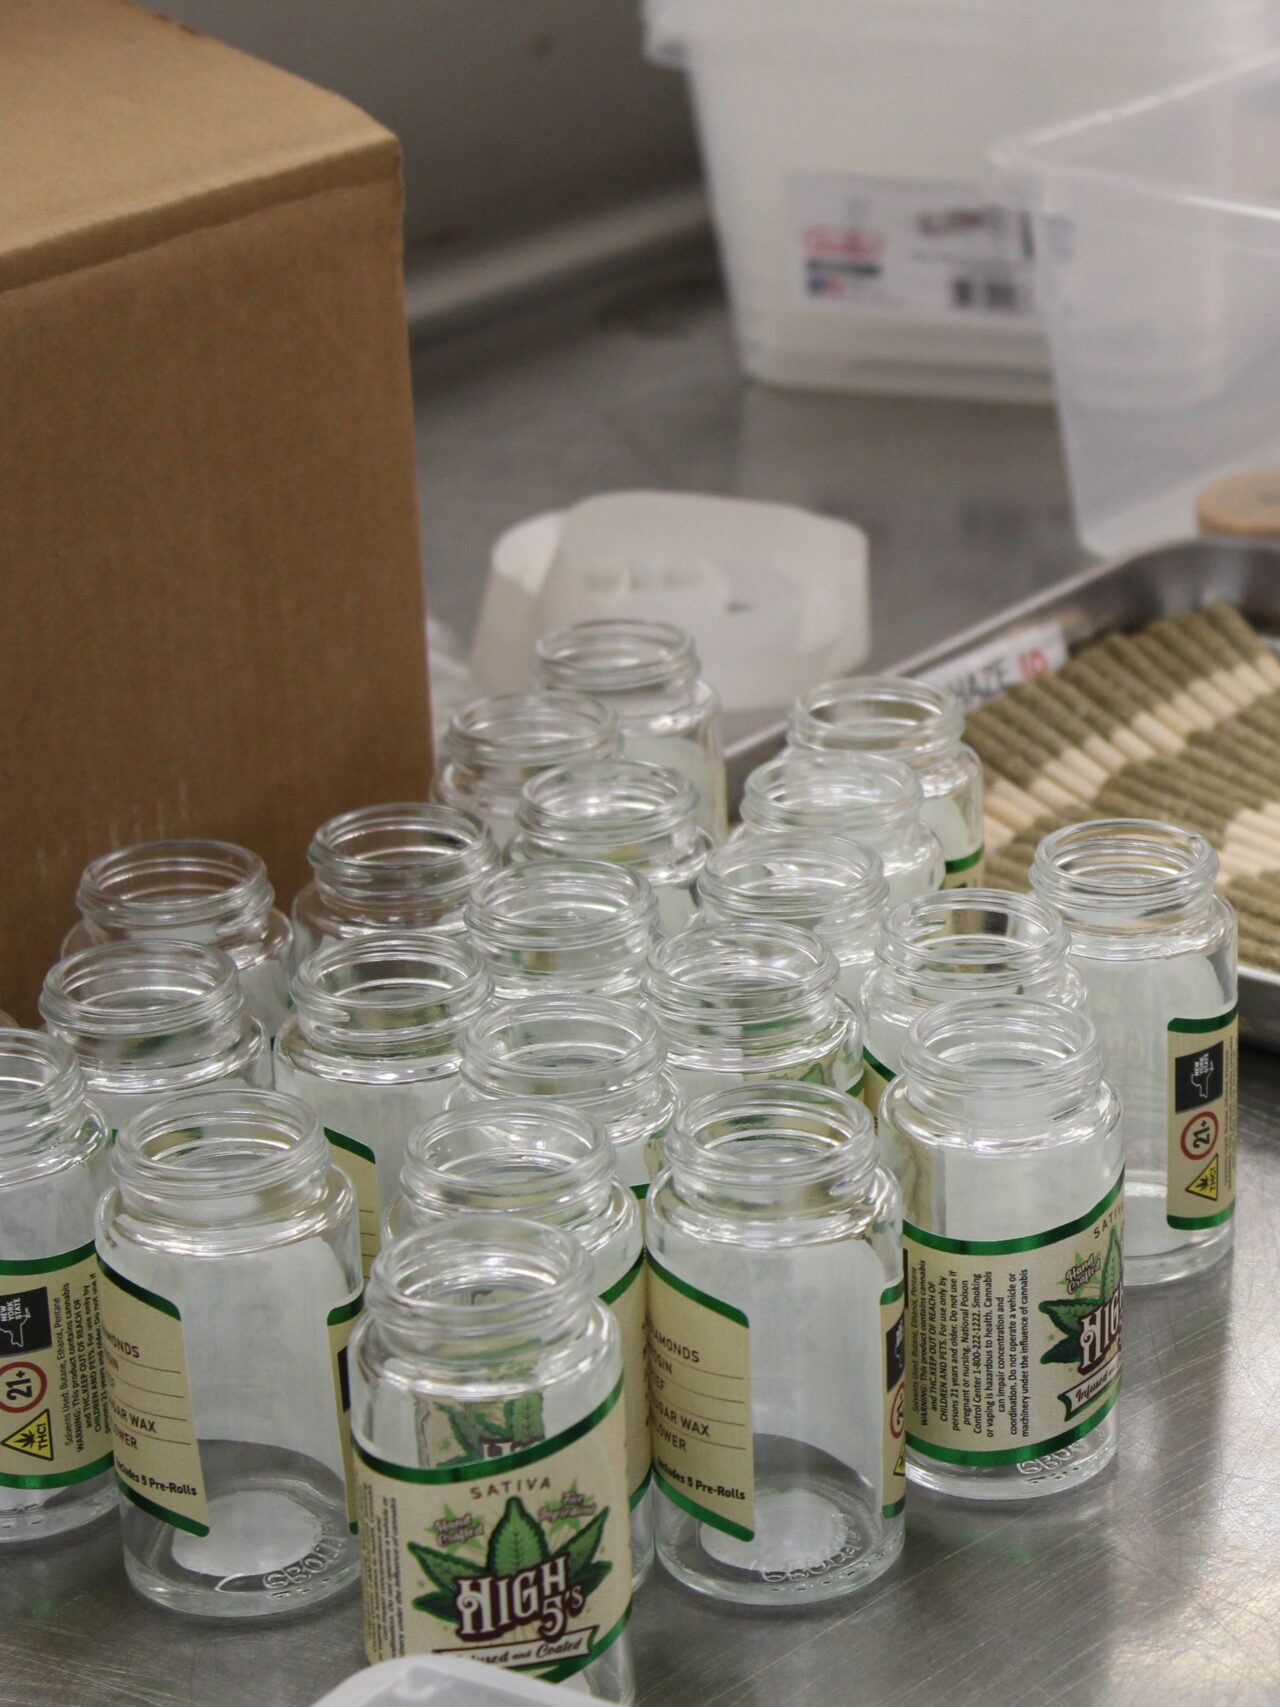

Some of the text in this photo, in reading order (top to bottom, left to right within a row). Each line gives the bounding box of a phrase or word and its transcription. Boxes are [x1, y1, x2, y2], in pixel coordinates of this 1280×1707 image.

[1193, 1120, 1210, 1148] 21+
[1093, 1200, 1124, 1239] SATIV
[1009, 1273, 1016, 1282] or
[1066, 1253, 1094, 1280] Hand
[1067, 1258, 1102, 1295] Crafted
[82, 1284, 90, 1296] by
[928, 1282, 936, 1294] OF
[938, 1276, 948, 1286] by
[14, 1297, 22, 1320] STATE
[74, 1299, 82, 1310] OF
[84, 1296, 92, 1315] only
[928, 1294, 936, 1322] REACH
[939, 1288, 948, 1306] only
[950, 1294, 958, 1308] not
[1008, 1284, 1016, 1312] vehicle
[75, 1311, 84, 1339] REACH
[950, 1310, 958, 1322] Do
[961, 1308, 969, 1343] National
[86, 1333, 94, 1346] For
[929, 1324, 936, 1335] OF
[939, 1323, 947, 1336] For
[950, 1324, 958, 1347] older.
[1008, 1320, 1018, 1352] operate
[1079, 1287, 1122, 1371] HIG
[78, 1341, 85, 1352] OF
[653, 1329, 700, 1364] AMONDS
[920, 1332, 928, 1364] product
[950, 1348, 958, 1364] and
[972, 1273, 982, 1434] Control Center 1-800-222-1222. Smoking
[984, 1270, 995, 1438] or vaping is hazardous to health. Cannabis
[996, 1297, 1006, 1412] can impair concentration and
[1019, 1268, 1030, 1437] machinery under the influence of cannabis
[62, 1282, 84, 1453] WARNING: This product contains cannabis
[940, 1361, 948, 1380] AND
[962, 1345, 971, 1377] nursing.
[1008, 1354, 1016, 1368] not
[6, 1370, 32, 1401] 21+
[90, 1371, 98, 1390] AND
[951, 1365, 960, 1387] years
[963, 1378, 970, 1388] or
[1008, 1370, 1016, 1381] Do
[930, 1396, 938, 1412] and
[940, 1382, 948, 1422] CHILDREN
[950, 1388, 959, 1398] 21
[92, 1391, 102, 1432] CHILDREN
[920, 1384, 928, 1426] WARNING:
[951, 1400, 960, 1432] persons
[962, 1390, 972, 1426] pregnant
[1008, 1382, 1018, 1436] coordination.
[84, 1412, 92, 1428] and
[130, 1412, 158, 1433] WAX
[680, 1415, 710, 1438] WAX
[37, 1422, 47, 1450] THC!
[142, 1474, 148, 1486] 5
[149, 1477, 198, 1496] Pre-Rolls
[470, 1477, 551, 1500] SATIVA
[687, 1476, 693, 1488] 5
[696, 1480, 746, 1500] Pre-Rolls
[455, 1554, 569, 1638] HIGH
[536, 1638, 583, 1659] Coated
